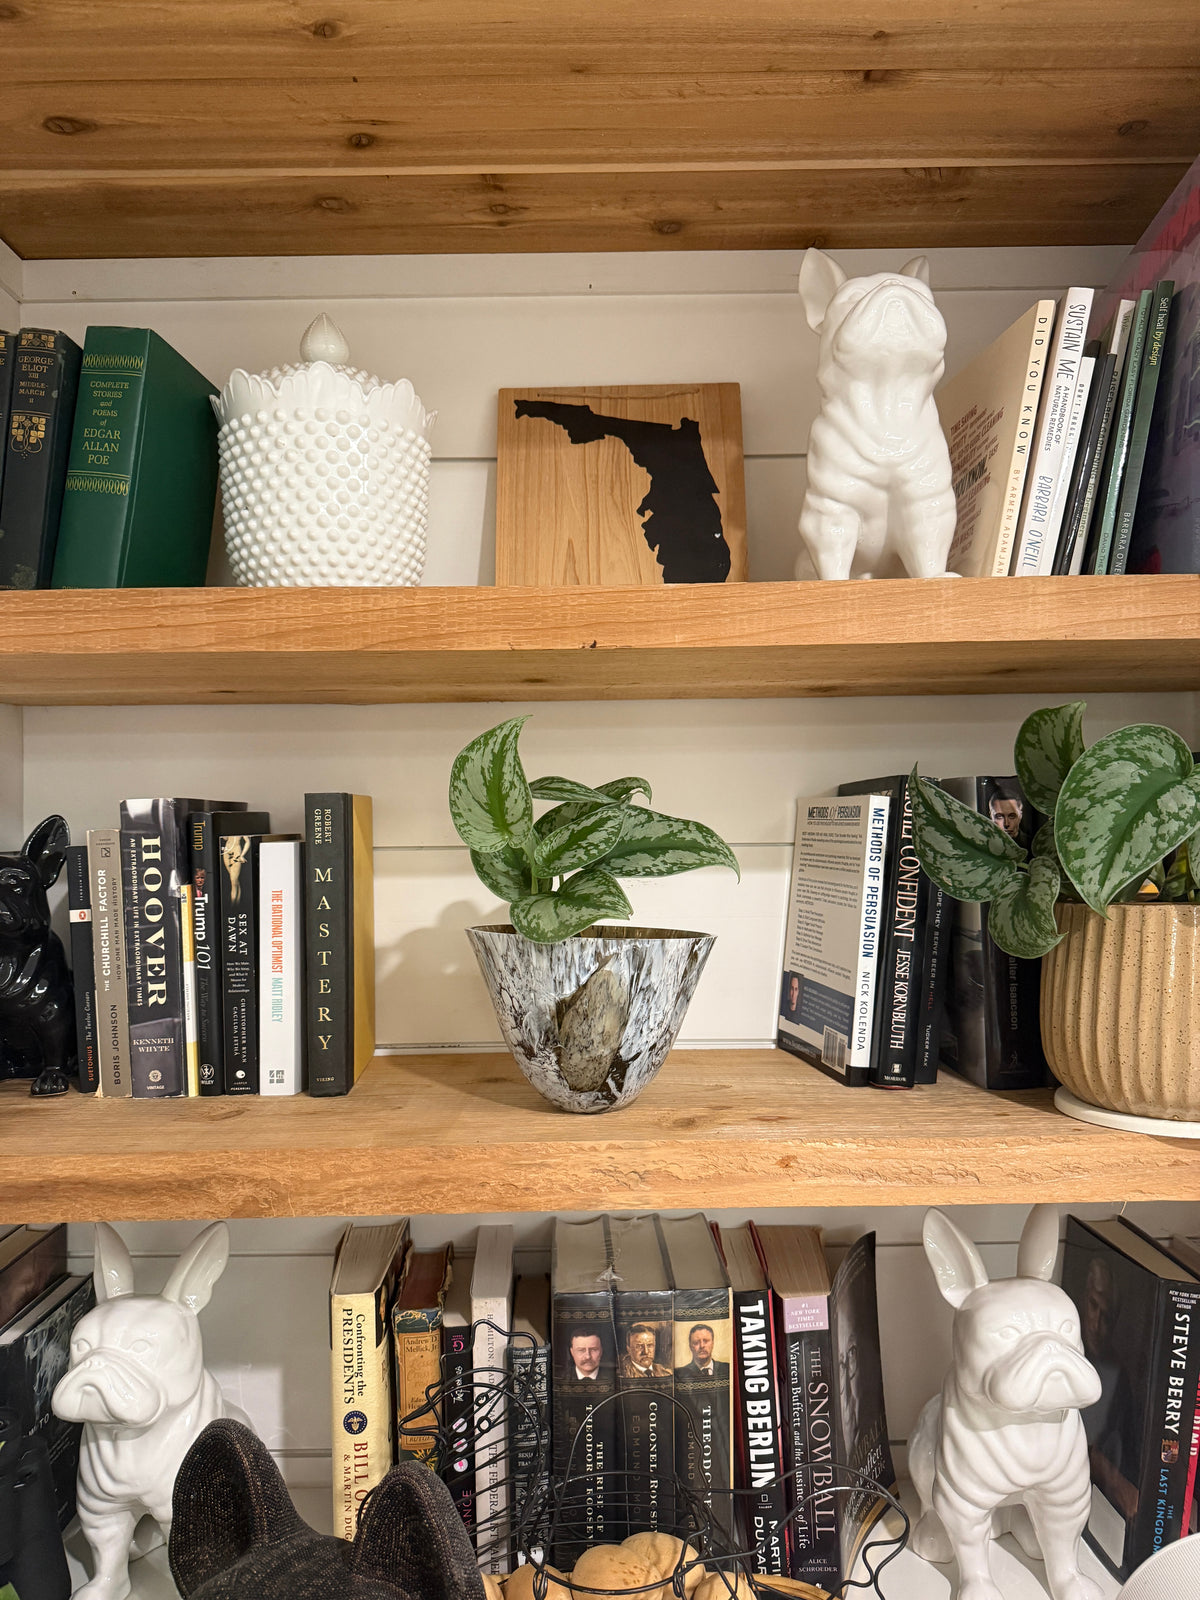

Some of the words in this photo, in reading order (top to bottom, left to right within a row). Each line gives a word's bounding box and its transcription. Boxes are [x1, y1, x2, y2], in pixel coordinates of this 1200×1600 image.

[1160, 297, 1169, 313] Self
[1035, 316, 1048, 346] DID
[1062, 303, 1087, 353] SUSTAIN
[1152, 331, 1164, 341] by
[1156, 313, 1165, 330] heal
[18, 356, 54, 365] GEORGE
[22, 364, 49, 373] ELIOT
[1149, 341, 1162, 366] design
[90, 381, 129, 389] COMPLETE
[1026, 359, 1040, 392] YOU
[1056, 358, 1075, 382] ME
[18, 388, 46, 397] MARCH
[92, 390, 123, 399] STORIES
[1051, 385, 1062, 417] NATURAL
[92, 409, 118, 417] POEMS
[1057, 393, 1069, 433] HANDBOOK
[83, 428, 121, 440] EDGAR
[1015, 405, 1033, 455] KNOW
[1044, 418, 1056, 452] REMEDIES
[1054, 434, 1061, 444] OF
[82, 441, 120, 453] ALLAN
[87, 454, 110, 465] POE
[1013, 468, 1021, 483] BY
[1006, 485, 1018, 521] ARMEN
[1031, 475, 1053, 524] BARBARA
[1119, 512, 1131, 550] BARBARA
[1023, 530, 1045, 568] O'NEILL
[314, 808, 322, 845] GREENE
[323, 808, 332, 844] ROBERT
[808, 806, 829, 818] METHODS
[837, 805, 862, 818] PERSUASION
[130, 838, 136, 847] AN
[192, 820, 206, 851] Trump
[869, 807, 886, 862] METHODS
[129, 848, 139, 905] EXTRAORDINARY
[868, 866, 881, 882] OF
[97, 869, 108, 912] FACTOR
[271, 890, 282, 903] THE
[893, 845, 921, 942] CONFIDENT
[133, 921, 140, 929] IN
[141, 835, 168, 1008] HOOVER
[193, 893, 209, 941] Trump
[238, 913, 248, 935] SEX
[271, 904, 283, 939] RATIONAL
[861, 886, 880, 959] PERSUASION
[934, 907, 942, 929] THEY
[99, 916, 111, 976] CHURCHILL
[228, 917, 237, 953] DAWN
[239, 940, 248, 955] AT
[932, 931, 940, 956] SERVE
[133, 930, 143, 986] EXTRAORDINARY
[196, 943, 212, 970] 101
[271, 940, 283, 974] OPTIMIST
[314, 867, 333, 1050] MASTERY
[897, 948, 911, 980] JESSE
[136, 987, 144, 1007] TIMES
[271, 977, 283, 997] MATT
[861, 971, 871, 996] NICK
[240, 998, 248, 1040] CHRISTOPHER
[271, 998, 283, 1023] RIDLEY
[857, 1001, 868, 1051] KOLENDA
[889, 980, 908, 1050] KORNBLUTH
[110, 1004, 120, 1052] JOHNSON
[133, 1037, 175, 1046] KENNETH
[924, 1023, 932, 1051] TUCKER
[86, 1045, 94, 1081] SUETONIUS
[138, 1045, 171, 1053] WHYTE
[922, 1051, 930, 1068] MAX
[112, 1055, 122, 1086] BORIS
[1171, 1296, 1197, 1305] BESTSELLING
[788, 1321, 824, 1330] BESTSELLER
[1170, 1312, 1191, 1370] STEVE
[342, 1308, 355, 1405] PRESIDENTS
[356, 1313, 366, 1379] Confronting
[739, 1300, 767, 1395] TAKING
[790, 1341, 800, 1384] Warren
[810, 1347, 822, 1377] THE
[791, 1385, 804, 1427] Buffett
[1164, 1375, 1185, 1435] BERRY
[649, 1401, 658, 1473] COLONEL
[745, 1399, 778, 1488] BERLIN
[793, 1430, 804, 1446] and
[353, 1441, 369, 1485] BILL
[795, 1447, 804, 1460] the
[808, 1382, 837, 1540] SNOWBALL
[344, 1465, 352, 1512] MARTIN
[596, 1476, 604, 1509] RISE
[1157, 1468, 1170, 1495] LAST
[795, 1513, 808, 1526] of
[1151, 1498, 1167, 1555] KINGDOM
[1166, 1504, 1174, 1519] THE
[798, 1526, 811, 1549] Life
